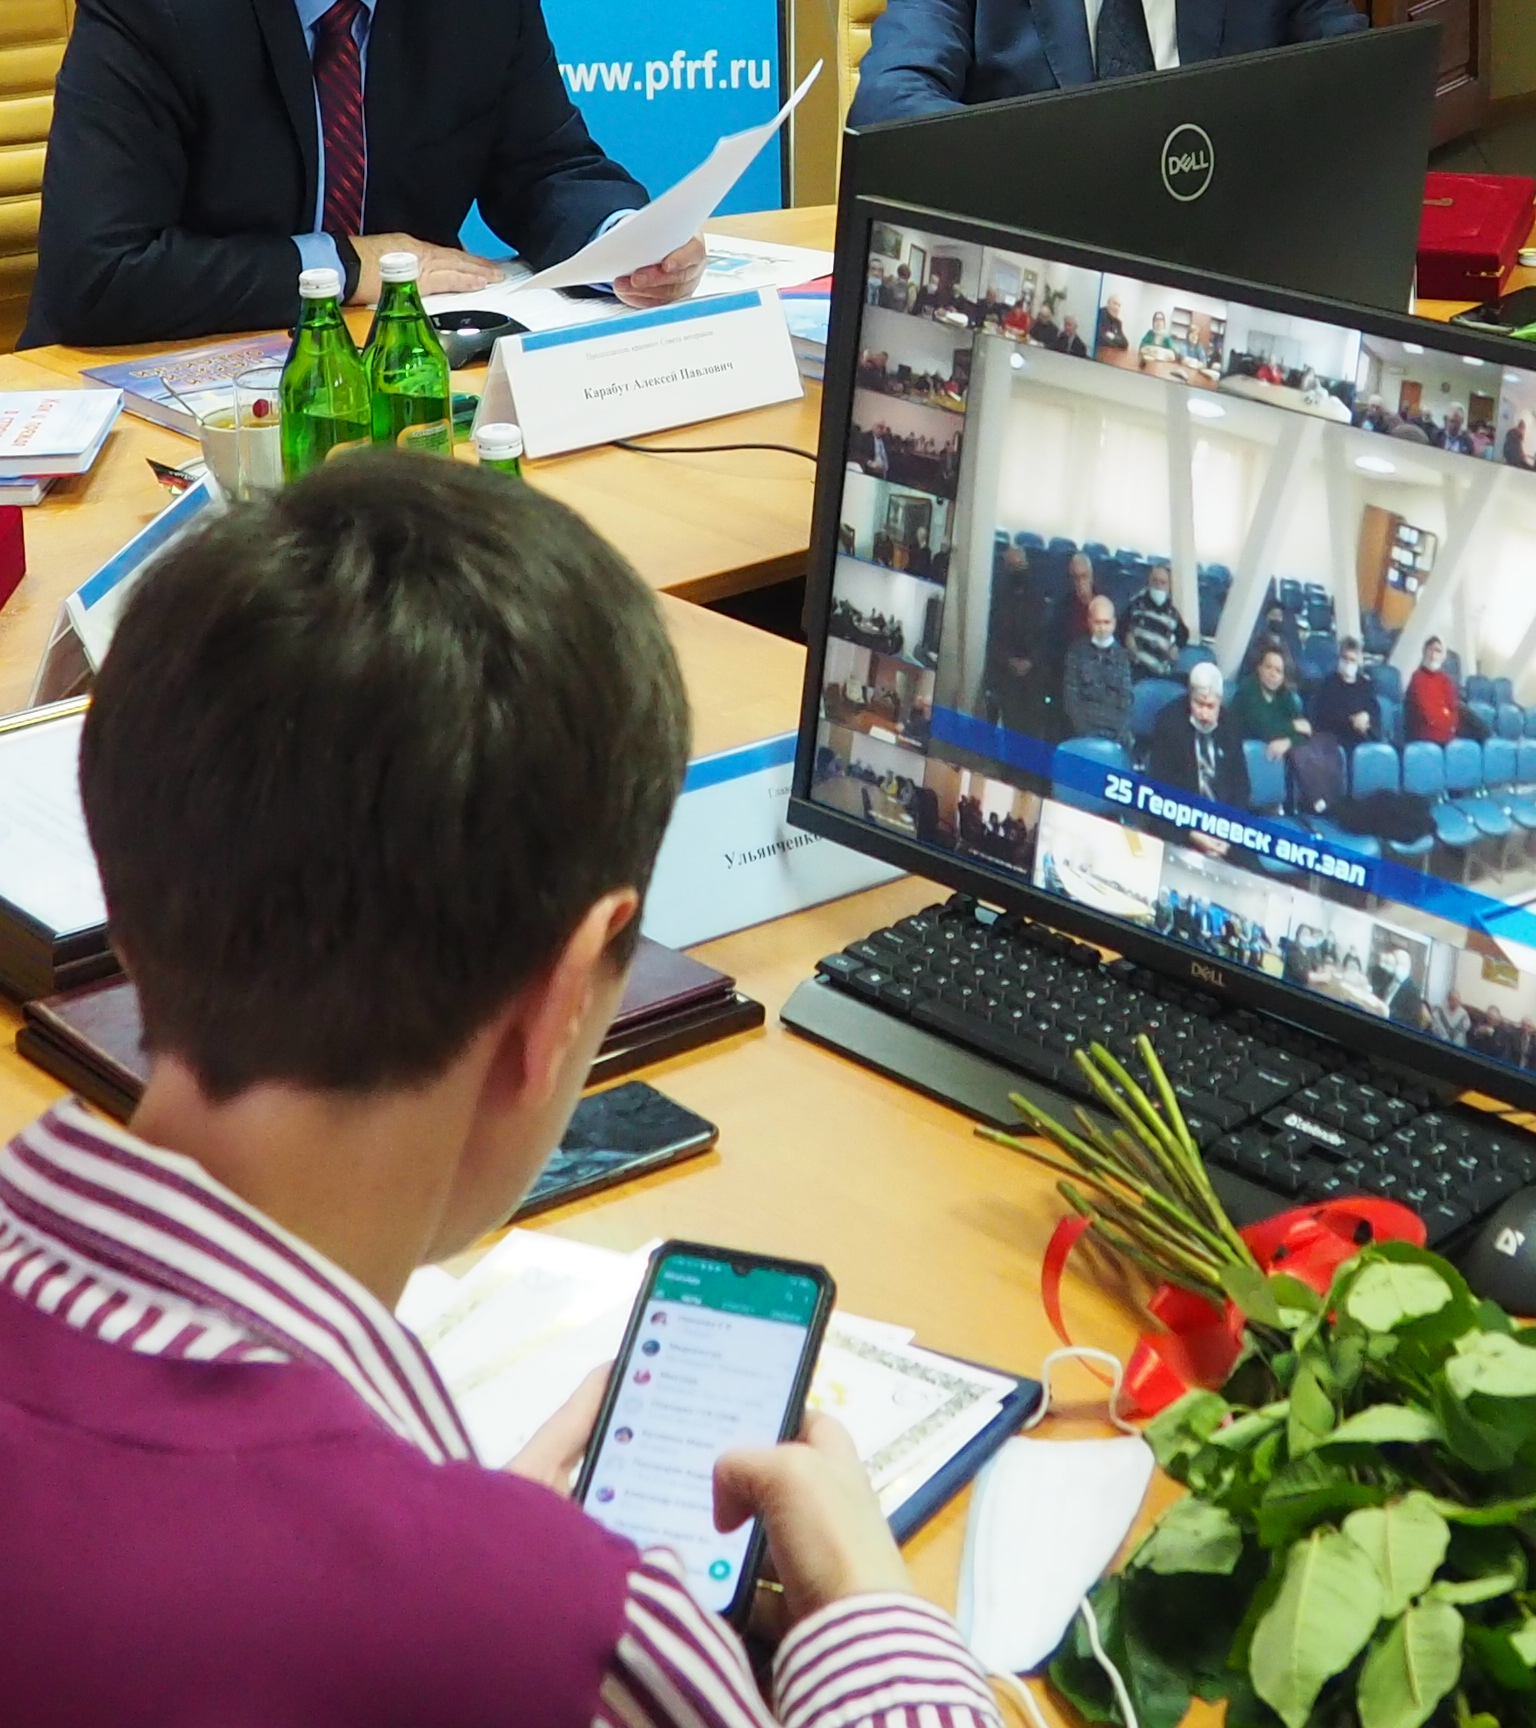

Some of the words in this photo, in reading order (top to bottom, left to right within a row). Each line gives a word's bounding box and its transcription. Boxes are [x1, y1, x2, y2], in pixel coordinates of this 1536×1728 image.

[558, 49, 771, 100] ww.pfrf.ru
[1168, 149, 1209, 176] DELL
[583, 383, 630, 401] Карабут
[633, 370, 678, 391] Алексей
[680, 361, 734, 381] Павлович
[1104, 774, 1133, 805] 25
[1137, 785, 1272, 854] Георгиевск
[1275, 838, 1367, 888] акт.зал
[1191, 961, 1226, 988] DELL
